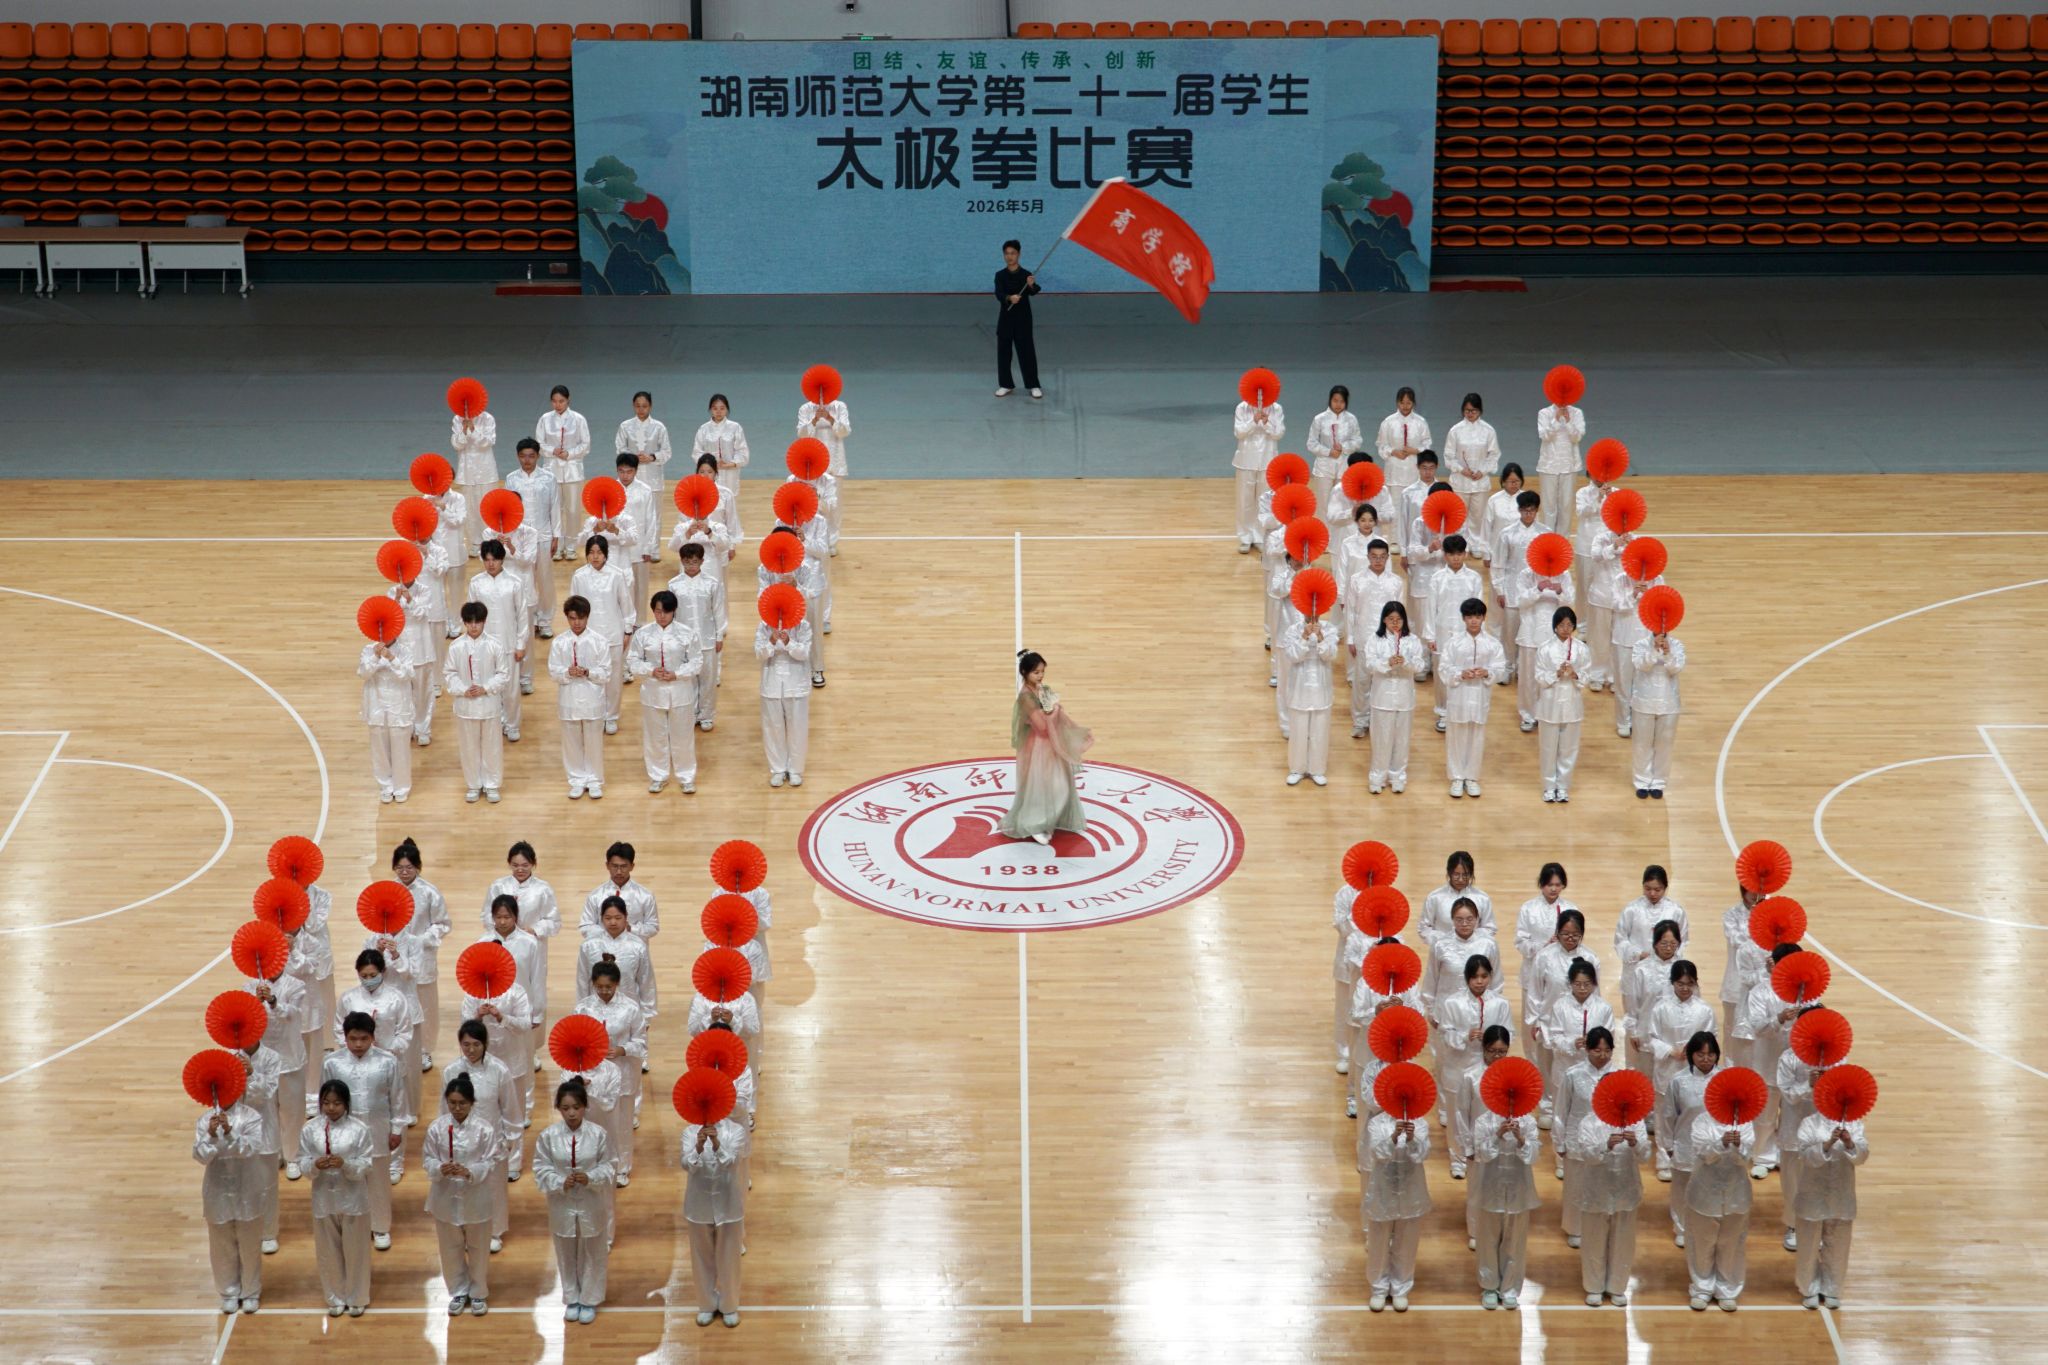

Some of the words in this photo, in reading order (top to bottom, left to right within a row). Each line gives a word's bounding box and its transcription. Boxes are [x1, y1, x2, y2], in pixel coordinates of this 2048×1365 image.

[853, 50, 1156, 70] 团结、友谊、传承、创新
[700, 73, 1310, 118] 湖南师范大学第二十一届学生
[816, 126, 1193, 190] 太极拳比赛
[966, 199, 1044, 214] 2026年5月
[843, 841, 905, 891] HUNAN
[903, 887, 1057, 914] NORMAL
[1065, 838, 1199, 911] UNIVERSITY
[980, 865, 1060, 876] 1938
